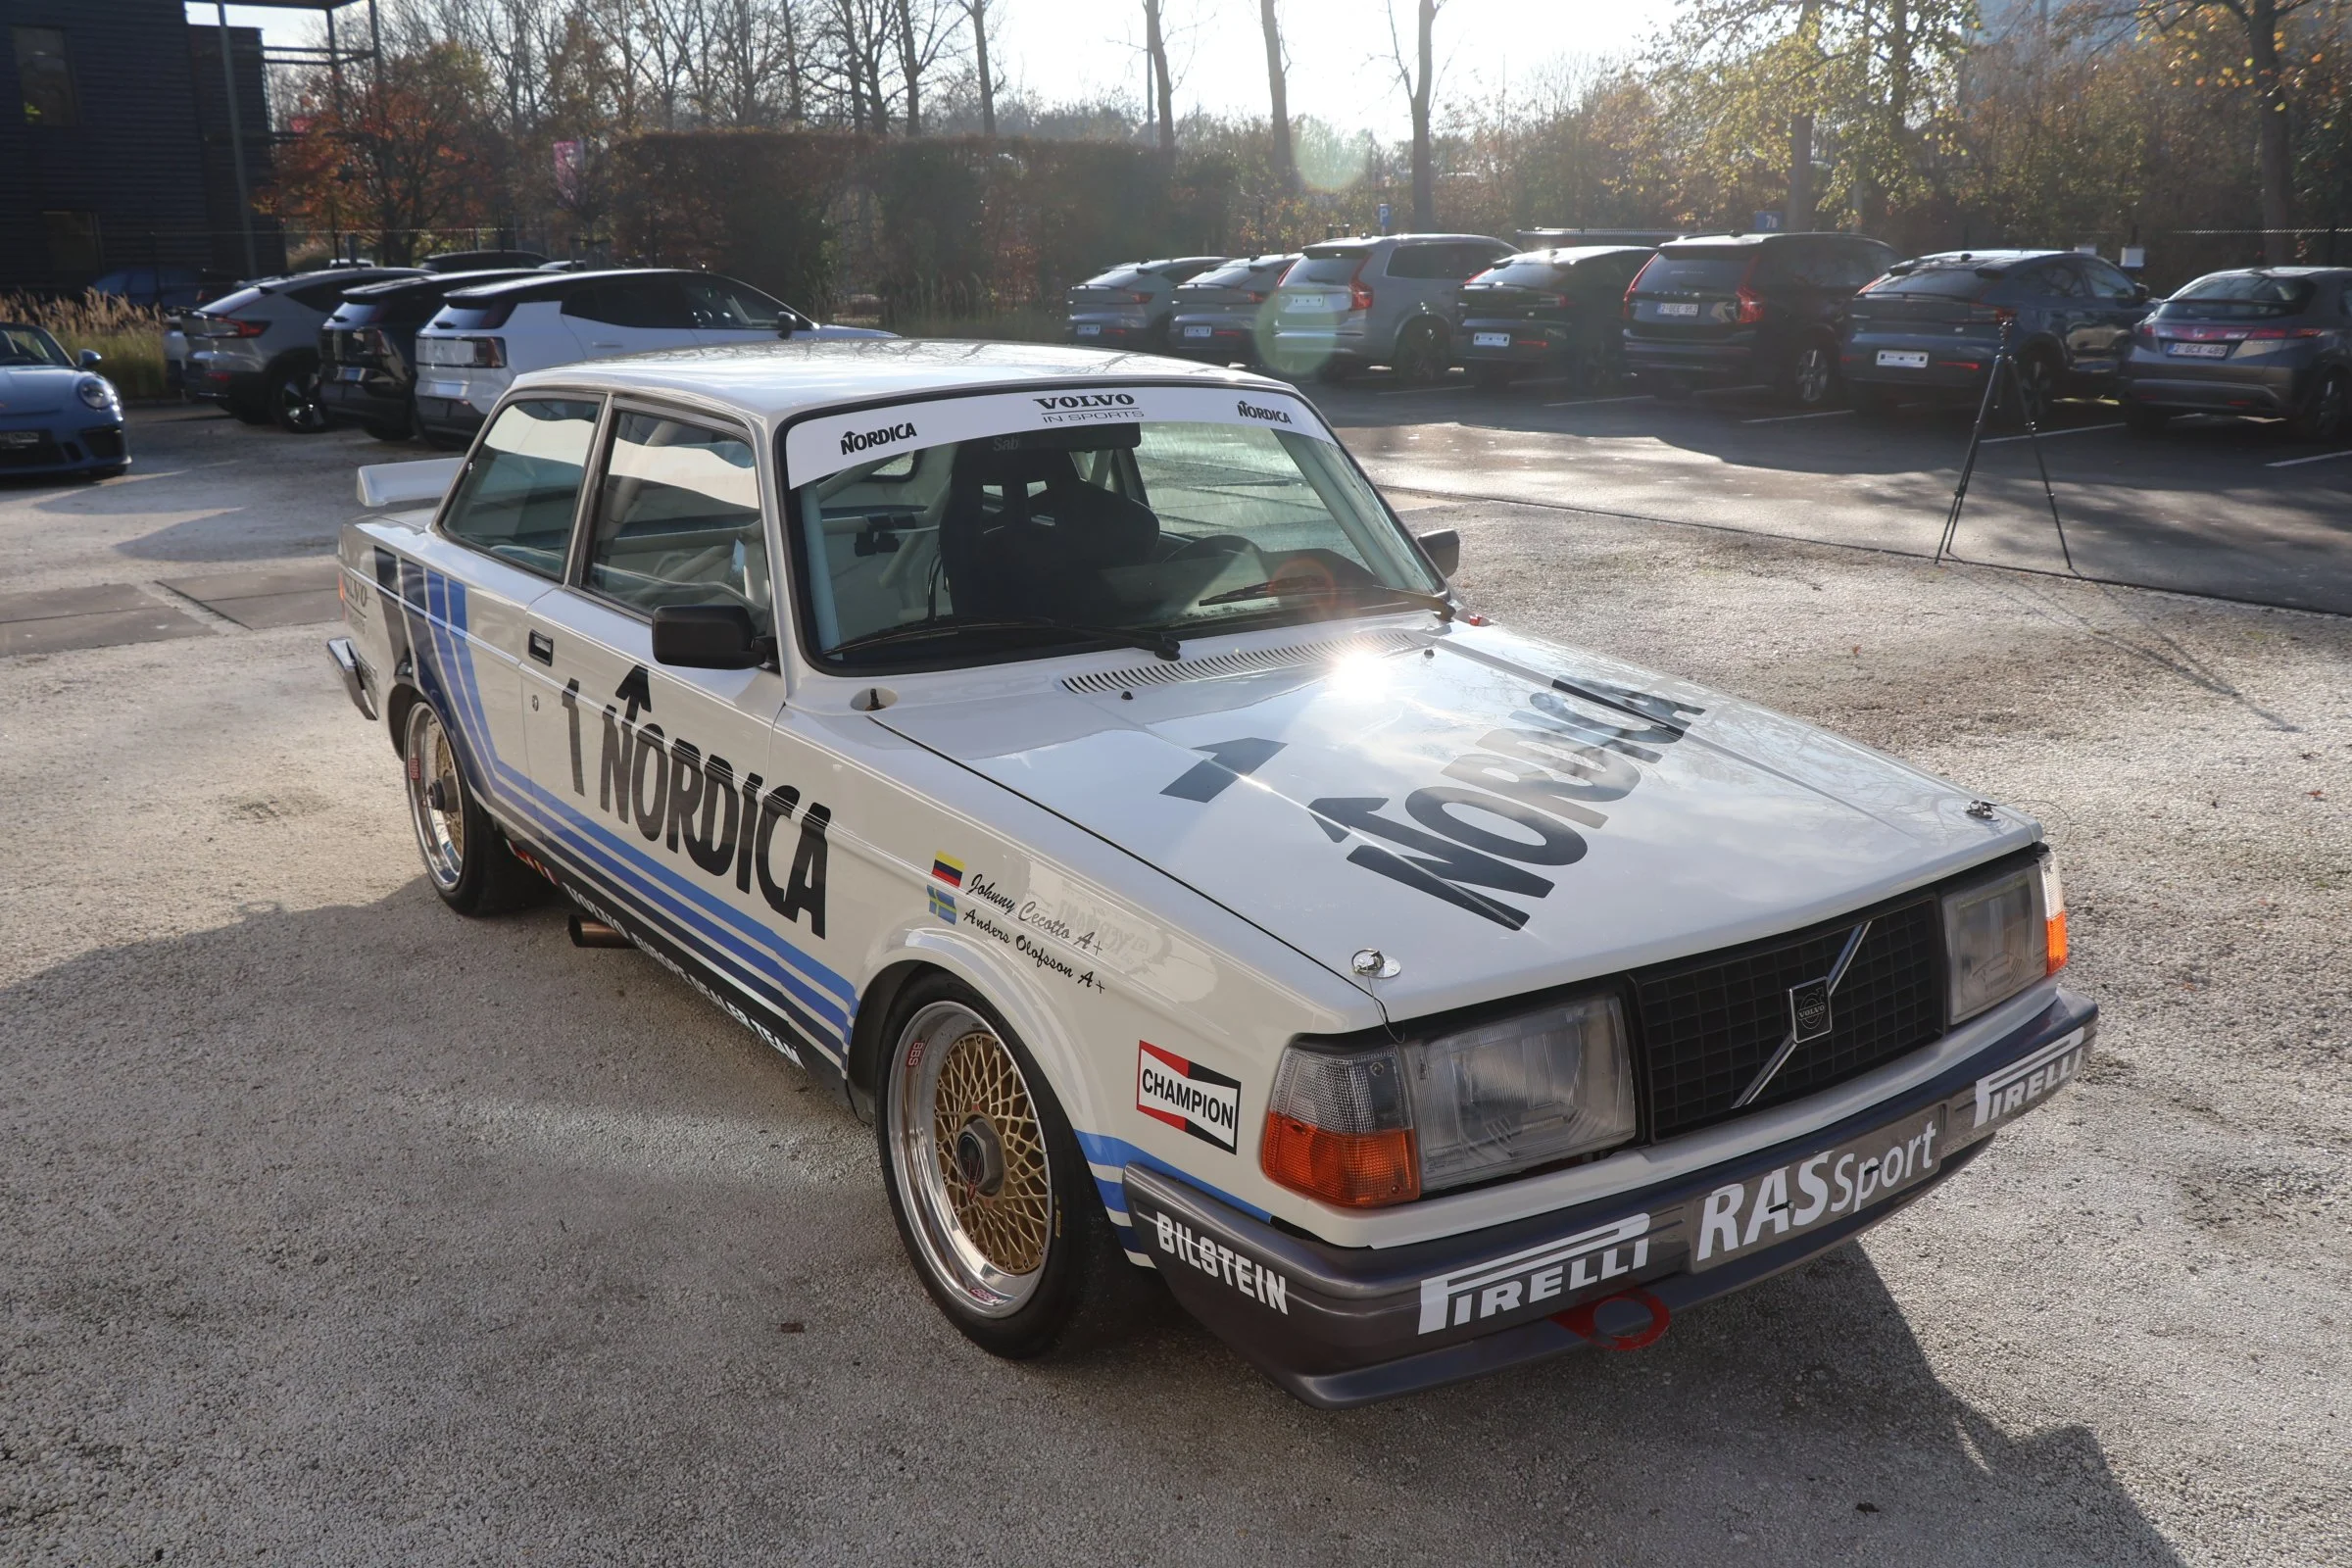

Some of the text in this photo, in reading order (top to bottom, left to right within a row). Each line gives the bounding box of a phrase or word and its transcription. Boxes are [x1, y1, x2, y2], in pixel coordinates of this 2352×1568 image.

[1032, 393, 1135, 410] VOLVO
[1068, 411, 1145, 421] SPORTS
[1237, 400, 1293, 424] NORDICA
[840, 422, 917, 456] NORDICA
[600, 664, 831, 940] NORDICA
[1308, 675, 1706, 930] NORDICA
[965, 873, 1016, 915] Johnny
[1017, 901, 1070, 940] Cecotto
[963, 908, 1010, 944] Anders
[1015, 934, 1074, 978] Olofsson
[1798, 1004, 1826, 1018] VOLVO
[750, 1018, 806, 1069] TEAM
[907, 1042, 924, 1066] BBS
[1142, 1068, 1234, 1130] CHAMPION
[1973, 1026, 2085, 1129] PIRELLI
[1156, 1211, 1289, 1315] BILSTEIN
[1418, 1212, 1651, 1336] PIRELLI
